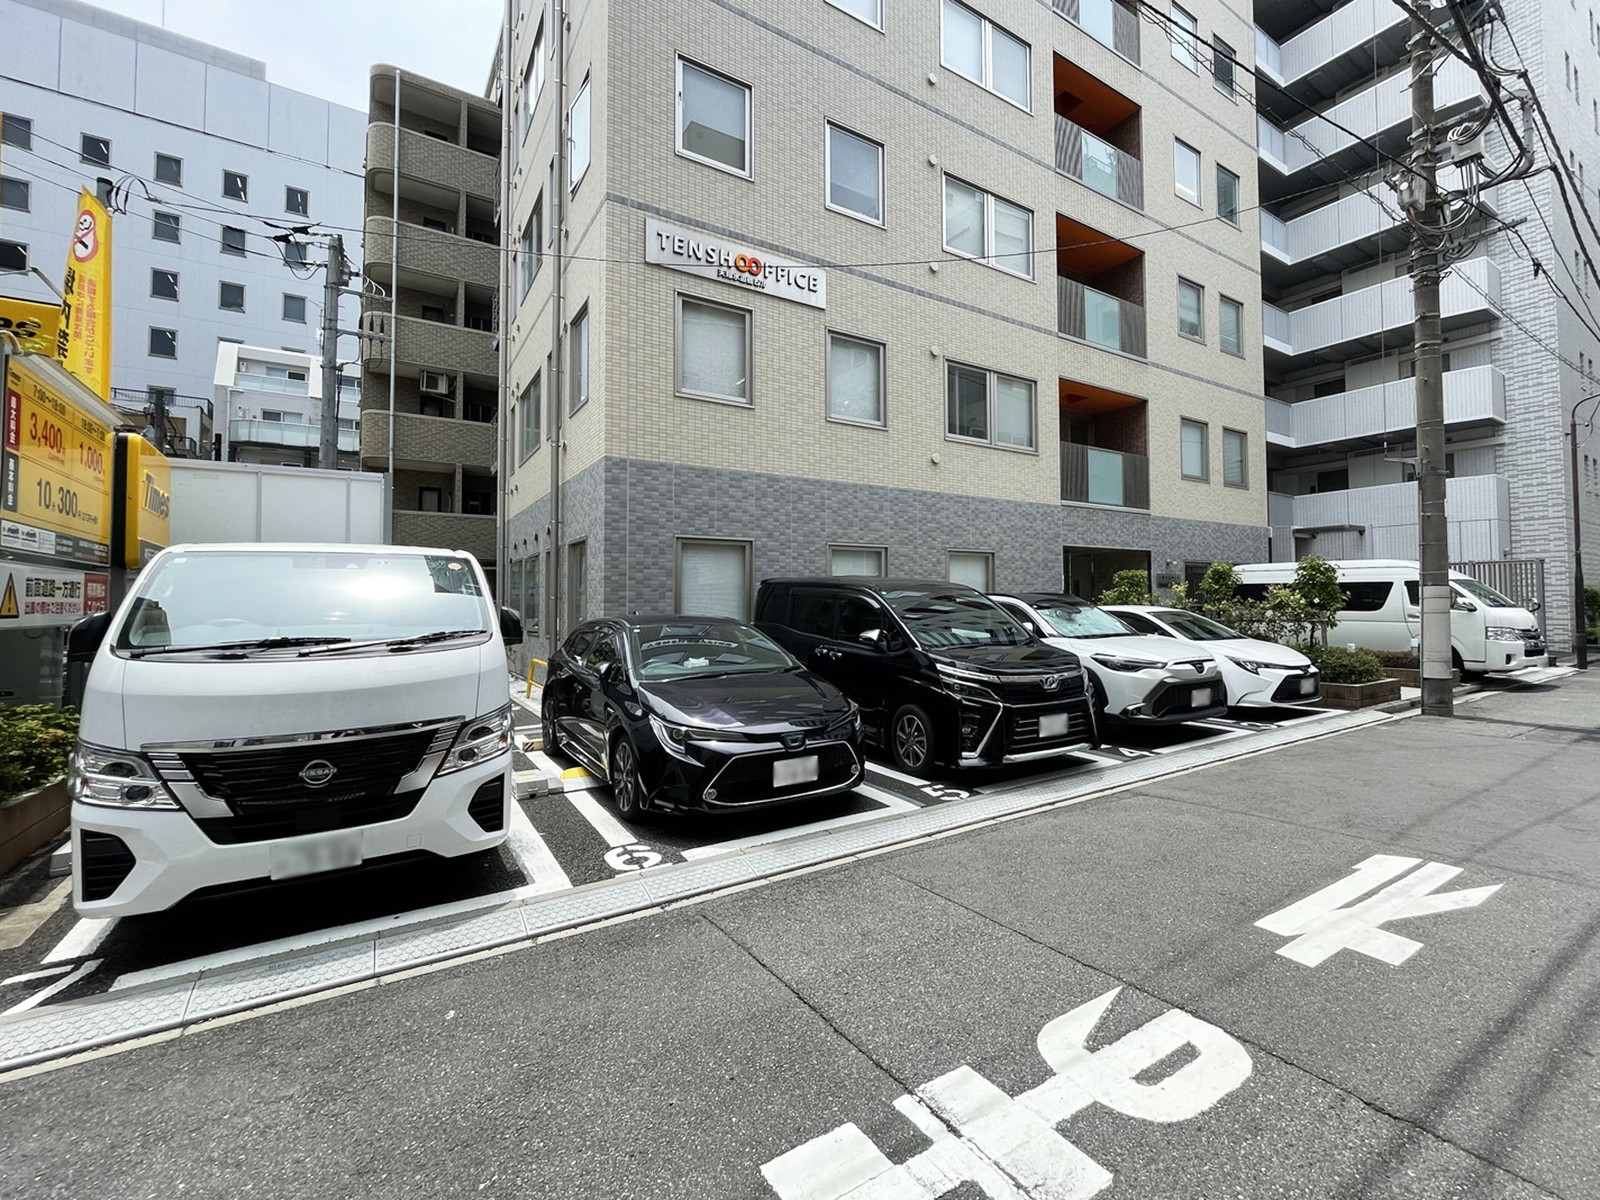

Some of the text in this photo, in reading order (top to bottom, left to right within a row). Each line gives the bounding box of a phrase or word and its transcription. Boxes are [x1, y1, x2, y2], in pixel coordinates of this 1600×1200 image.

[143, 472, 171, 518] Times
[25, 576, 82, 599] 前面道路一方通行
[298, 767, 338, 777] NISSAN
[919, 784, 971, 801] 5
[603, 844, 663, 871] 6
